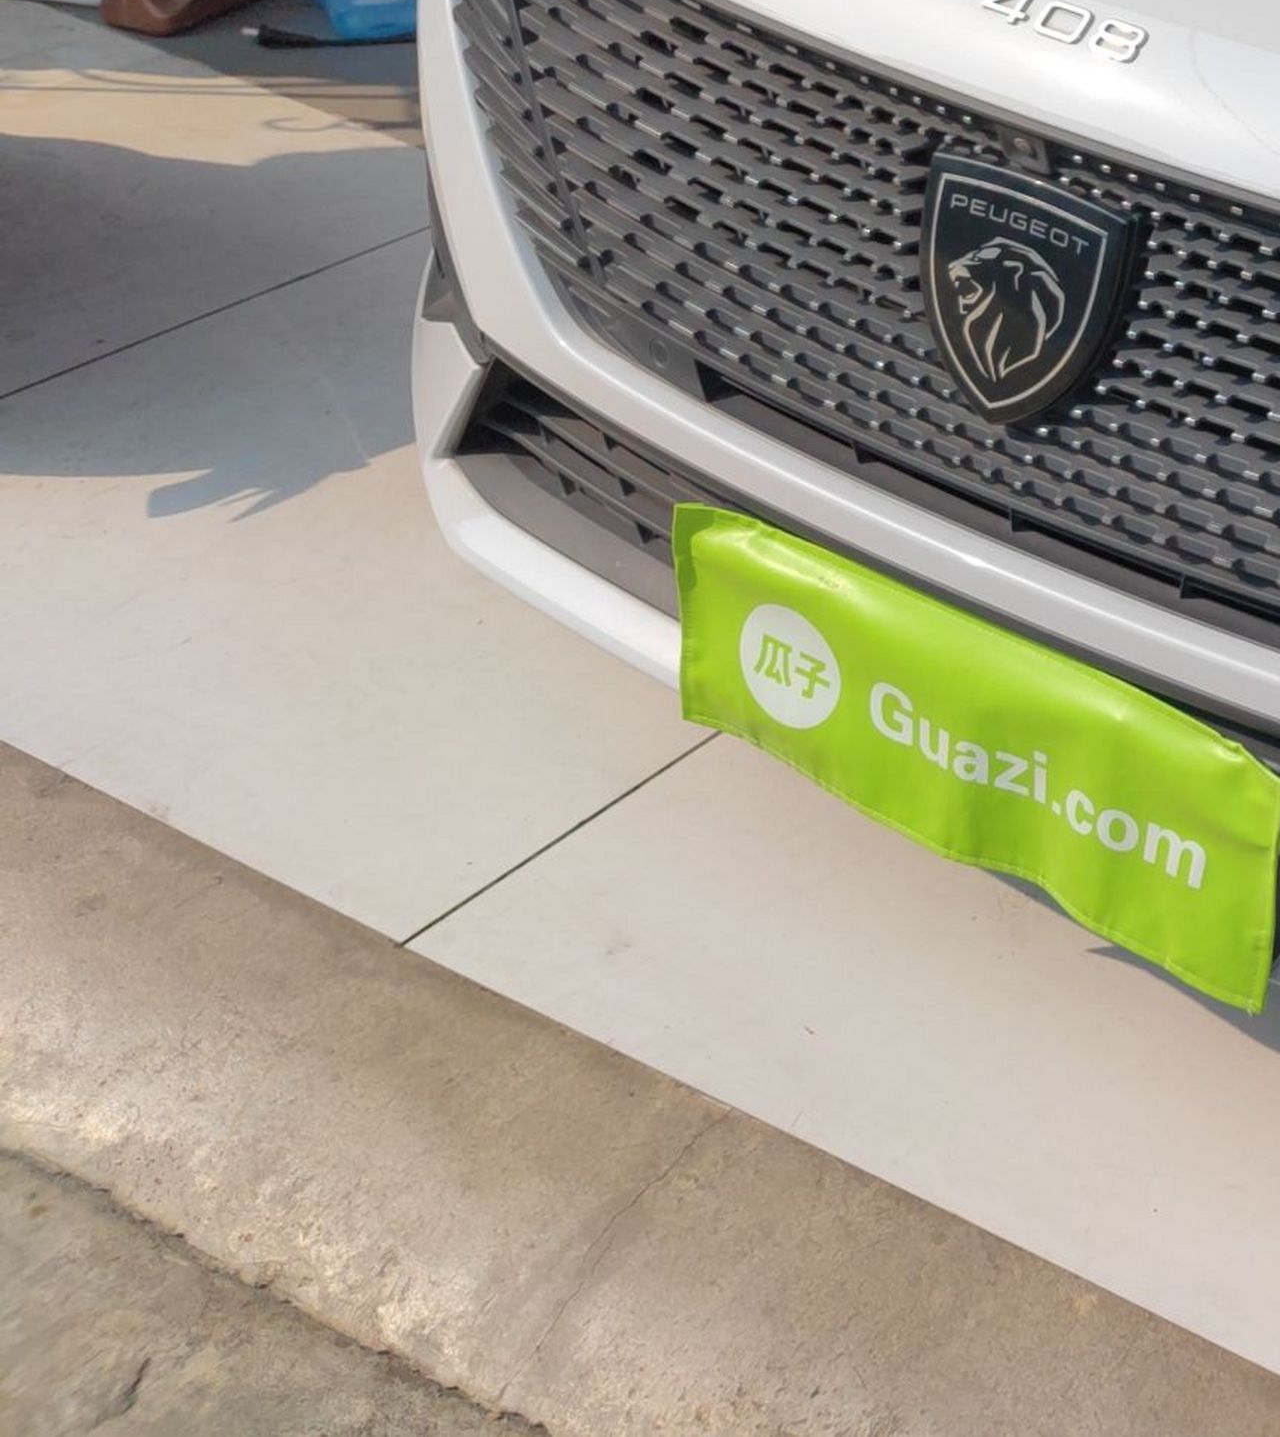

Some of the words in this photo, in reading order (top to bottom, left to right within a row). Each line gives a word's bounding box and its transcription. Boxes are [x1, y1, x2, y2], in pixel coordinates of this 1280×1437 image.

[950, 193, 1090, 255] PEUGEOT
[754, 634, 830, 700] 瓜子
[869, 681, 1207, 890] Guazi.com
